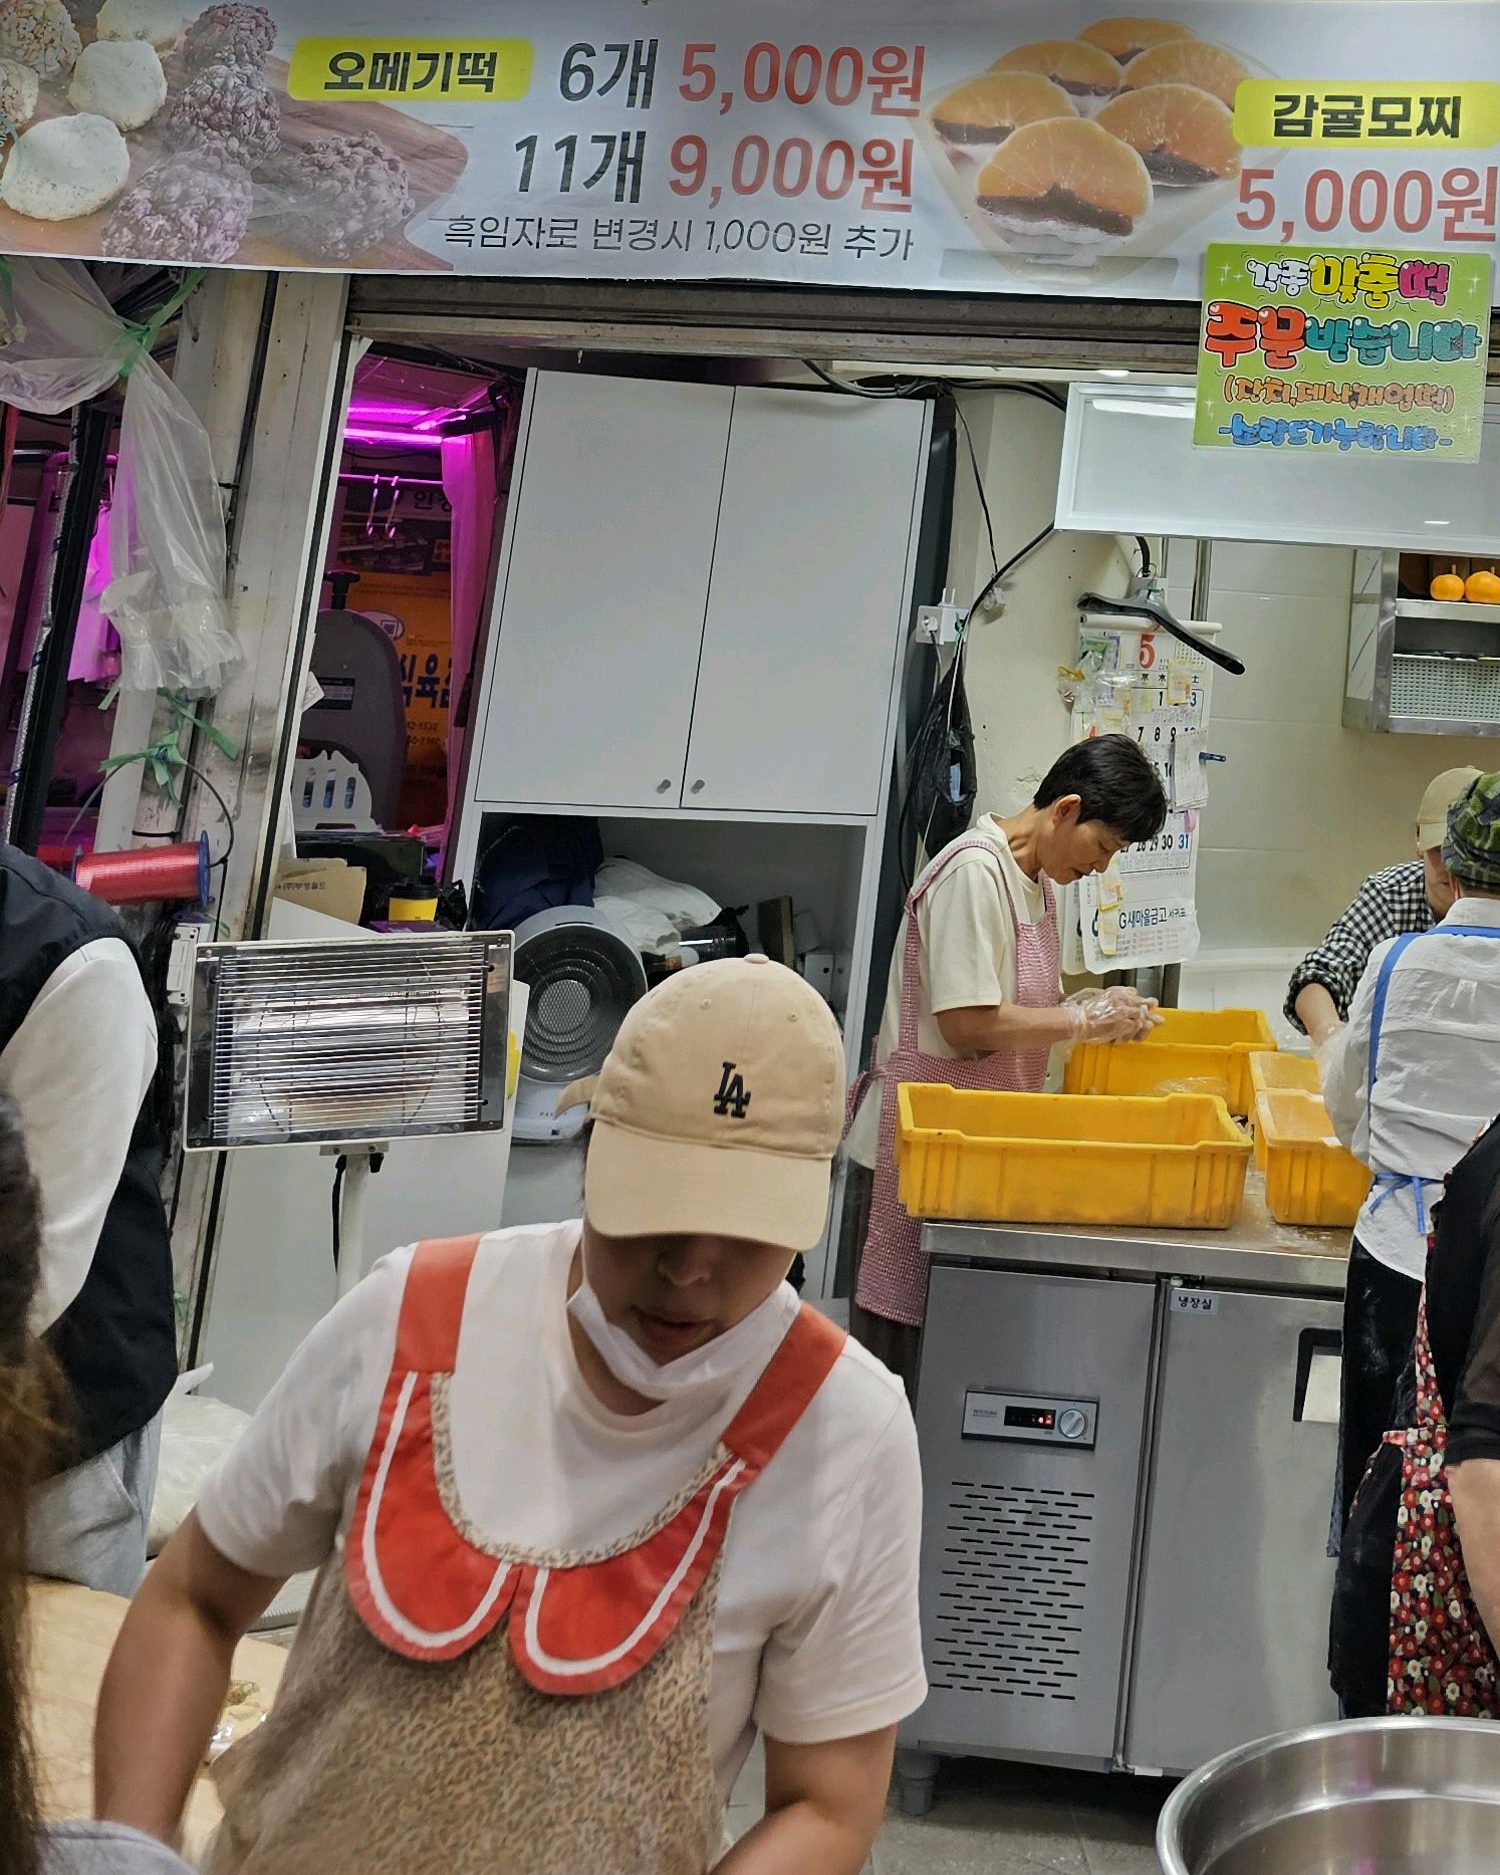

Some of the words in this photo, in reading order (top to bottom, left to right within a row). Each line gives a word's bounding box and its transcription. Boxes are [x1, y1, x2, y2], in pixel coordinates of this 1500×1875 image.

[324, 50, 498, 94] 오메기떡
[559, 39, 660, 108] 6개
[680, 41, 926, 117] 5,000원
[1273, 94, 1462, 138] 감귤모찌
[514, 131, 647, 204] 11개
[668, 133, 914, 214] 9,000원
[1235, 166, 1498, 244] 5,000원
[444, 215, 583, 251] 흑임자로
[593, 220, 692, 255] 변경시
[704, 222, 830, 257] 1,000원
[843, 226, 915, 261] 추가
[1139, 634, 1155, 669] 5
[1158, 691, 1164, 706] 1
[1154, 727, 1161, 742] 8
[1161, 835, 1173, 850] 30
[1178, 834, 1189, 849] 31
[713, 1061, 751, 1119] LA
[1178, 1295, 1213, 1310] 냉장실
